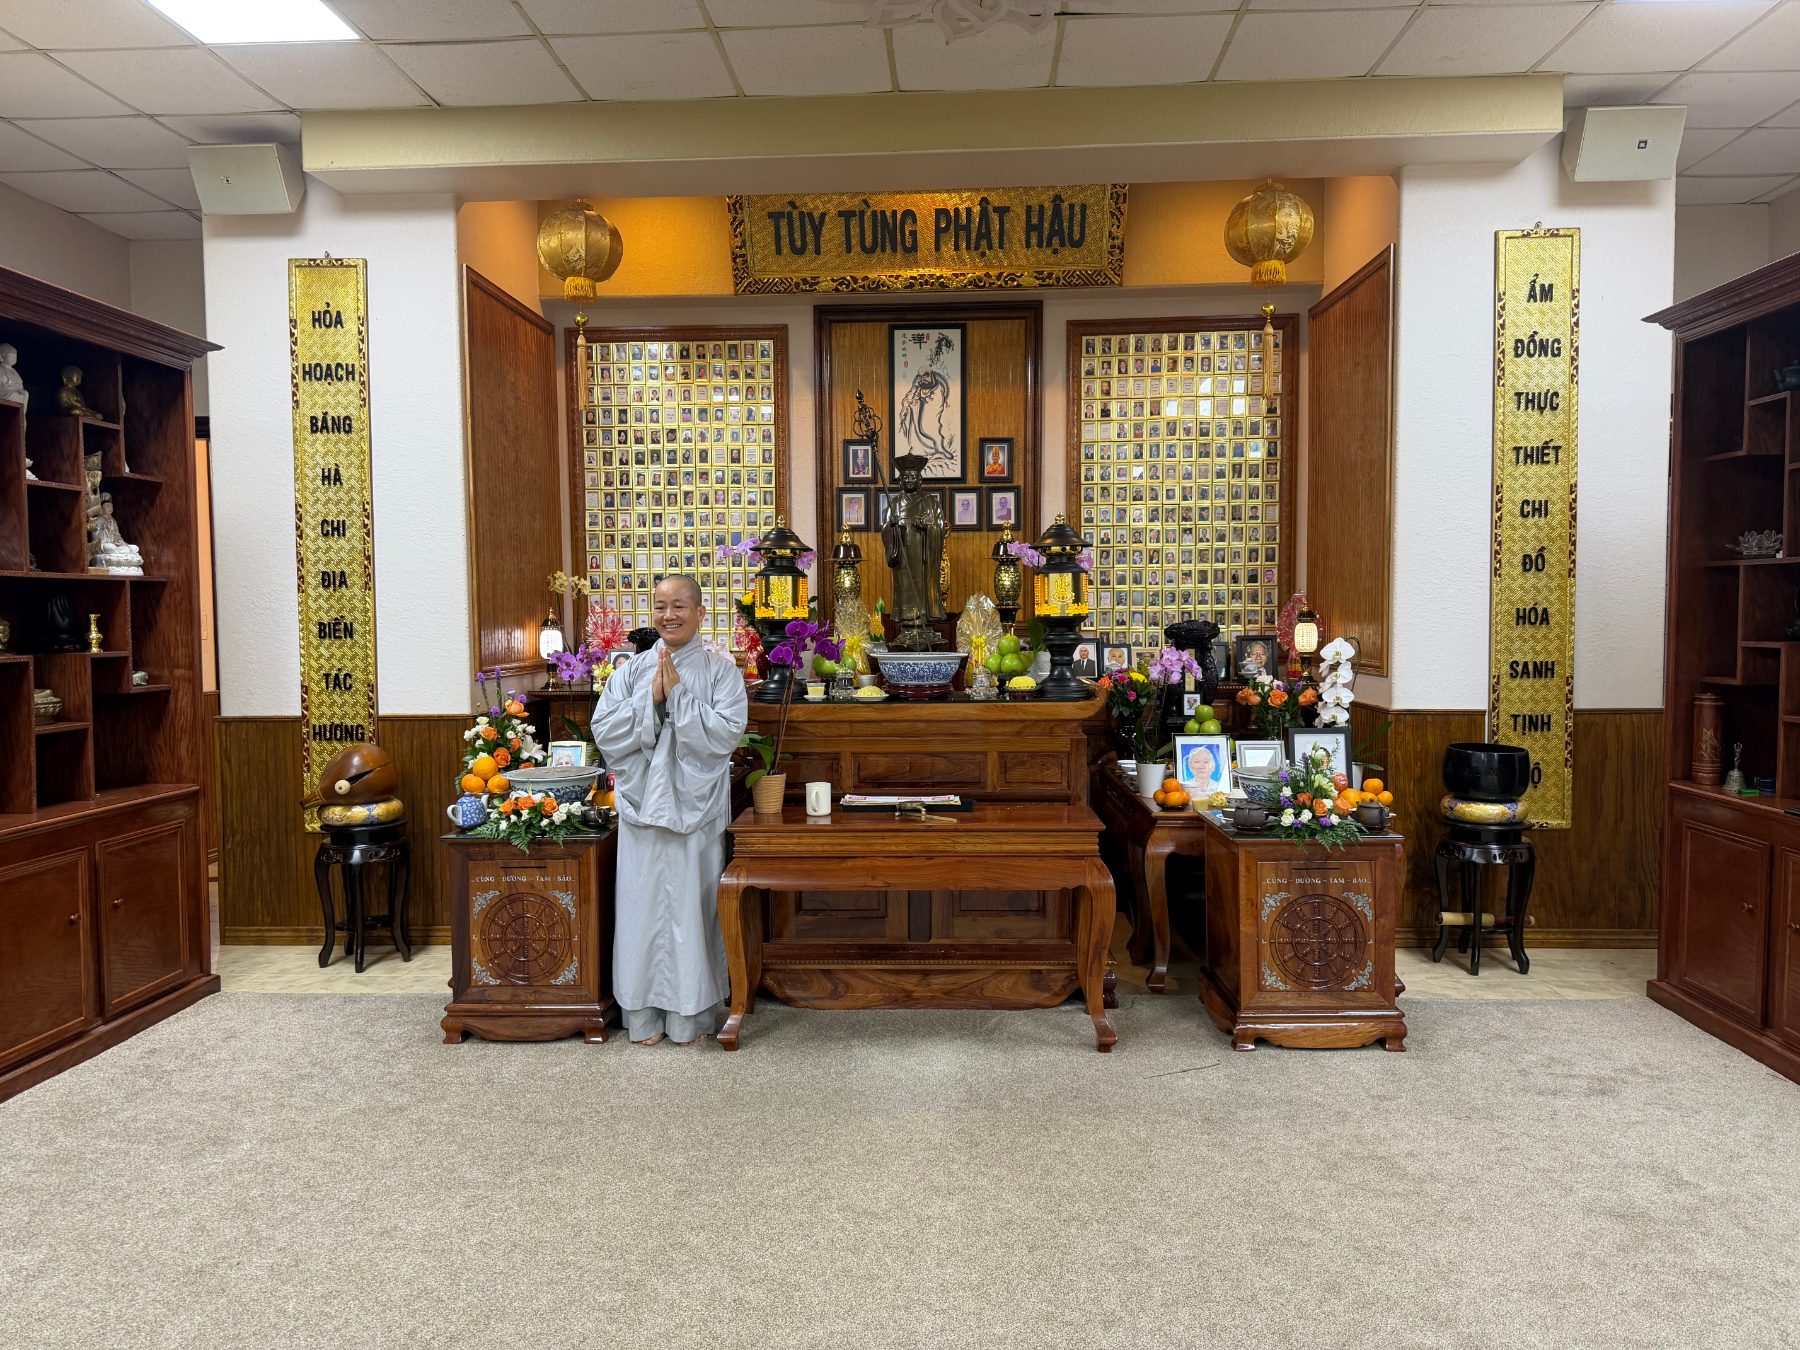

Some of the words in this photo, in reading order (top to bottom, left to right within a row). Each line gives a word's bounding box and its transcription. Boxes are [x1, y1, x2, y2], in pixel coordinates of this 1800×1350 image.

[768, 200, 827, 256] TÙY
[837, 199, 919, 254] TÙNG
[934, 196, 1010, 257] PHẬT
[1025, 194, 1088, 255] HẬU
[311, 302, 344, 329] HỎA
[302, 363, 356, 386] HOẠCH
[1514, 390, 1560, 415] THỰC
[309, 411, 353, 435] BĂNG
[1512, 438, 1562, 465] THIẾT
[321, 463, 344, 487] HÀ
[1519, 499, 1549, 519] CHI
[320, 518, 347, 538] CHI
[320, 570, 349, 592] ĐỊA
[1515, 602, 1551, 627] HÓA
[317, 614, 354, 641] BIẾN
[322, 667, 353, 692] TÁC
[1509, 660, 1556, 680] SANH
[311, 722, 366, 743] HƯƠNG
[1510, 713, 1552, 736] TỊNH
